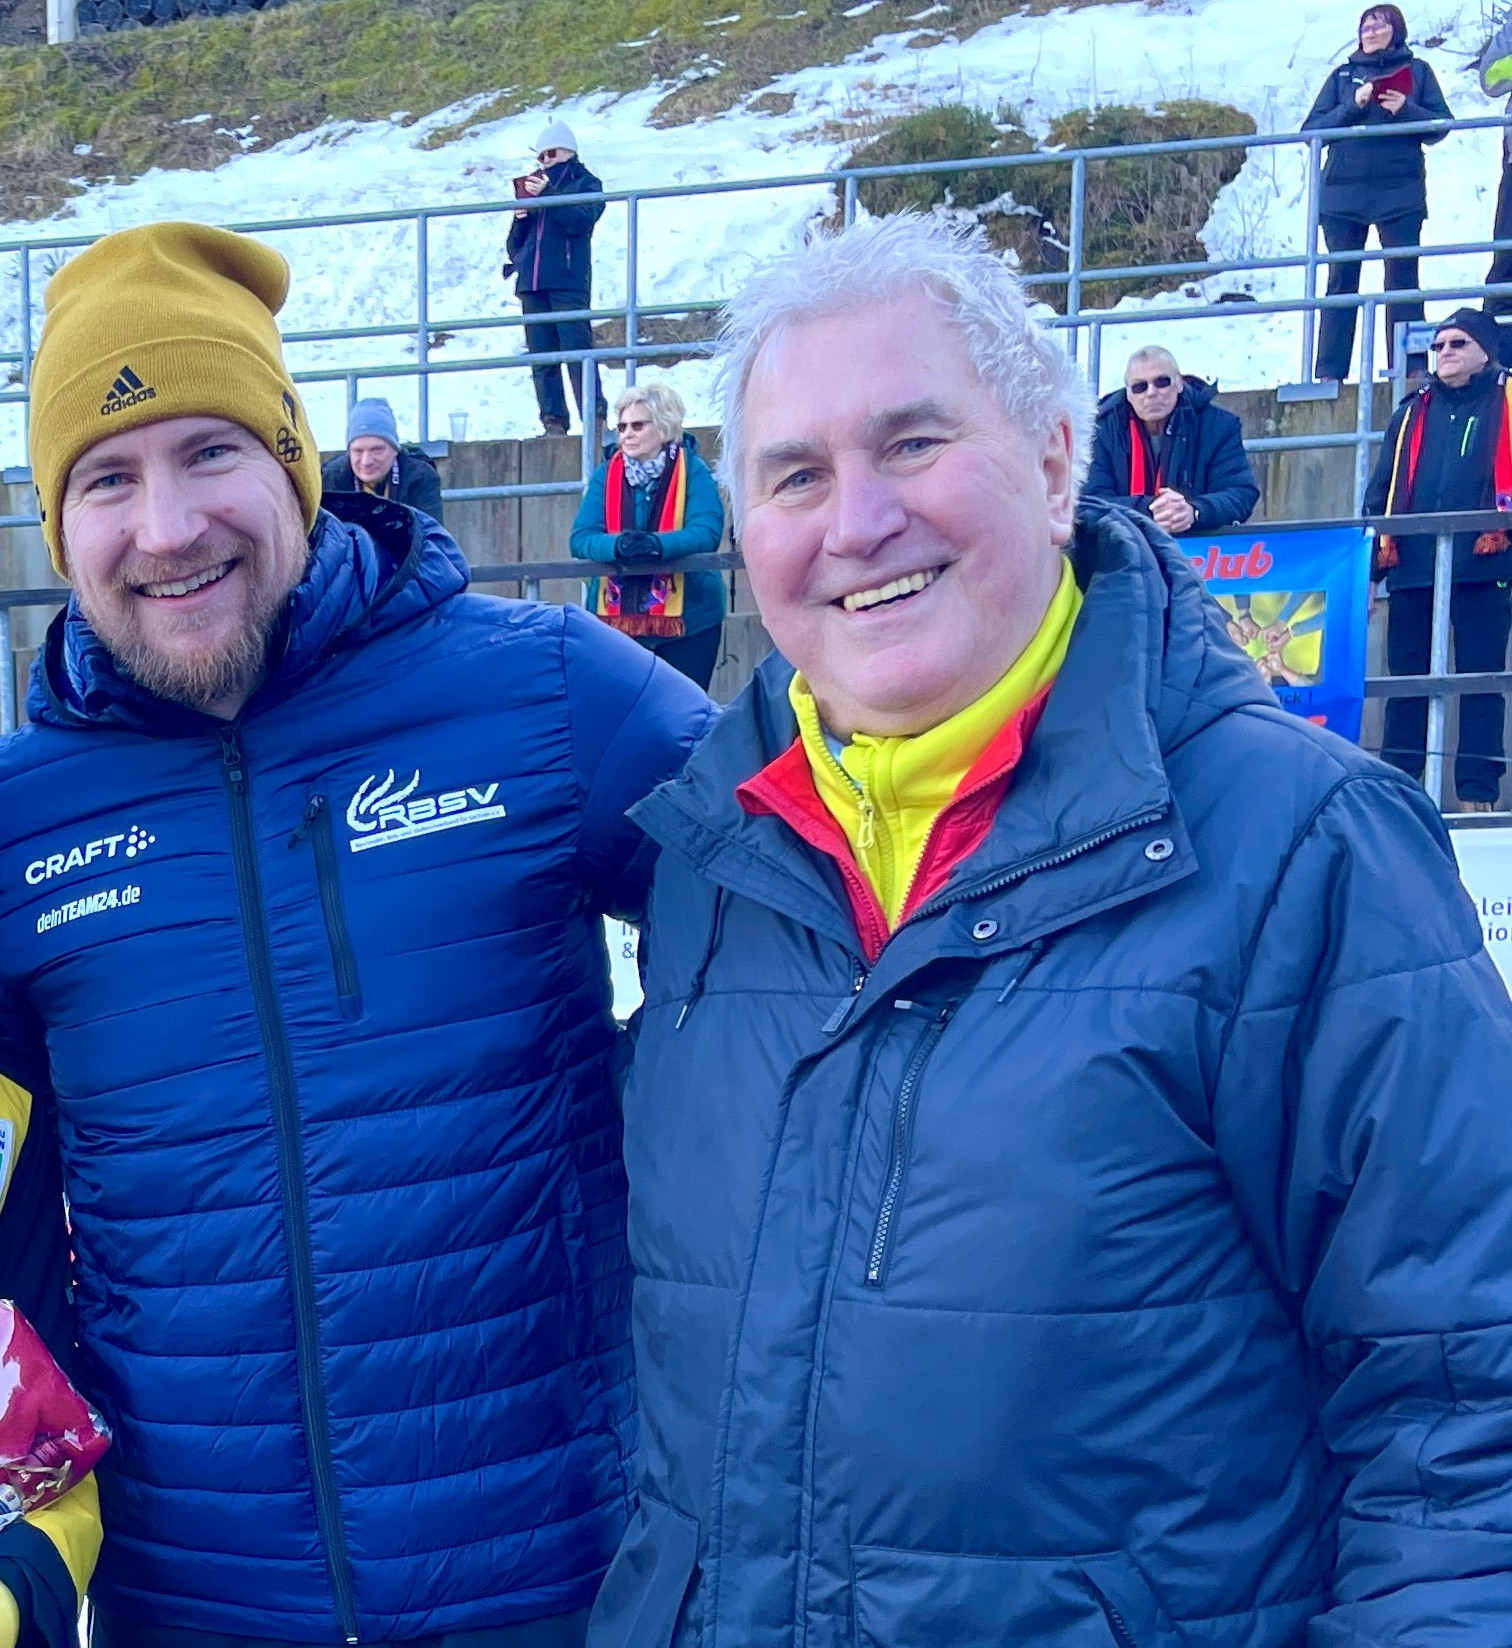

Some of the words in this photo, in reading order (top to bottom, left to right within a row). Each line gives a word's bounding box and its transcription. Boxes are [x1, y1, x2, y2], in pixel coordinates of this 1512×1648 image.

[100, 387, 157, 416] adidas
[25, 834, 125, 885] CRAFT
[37, 885, 141, 934] deinTEAM24.de
